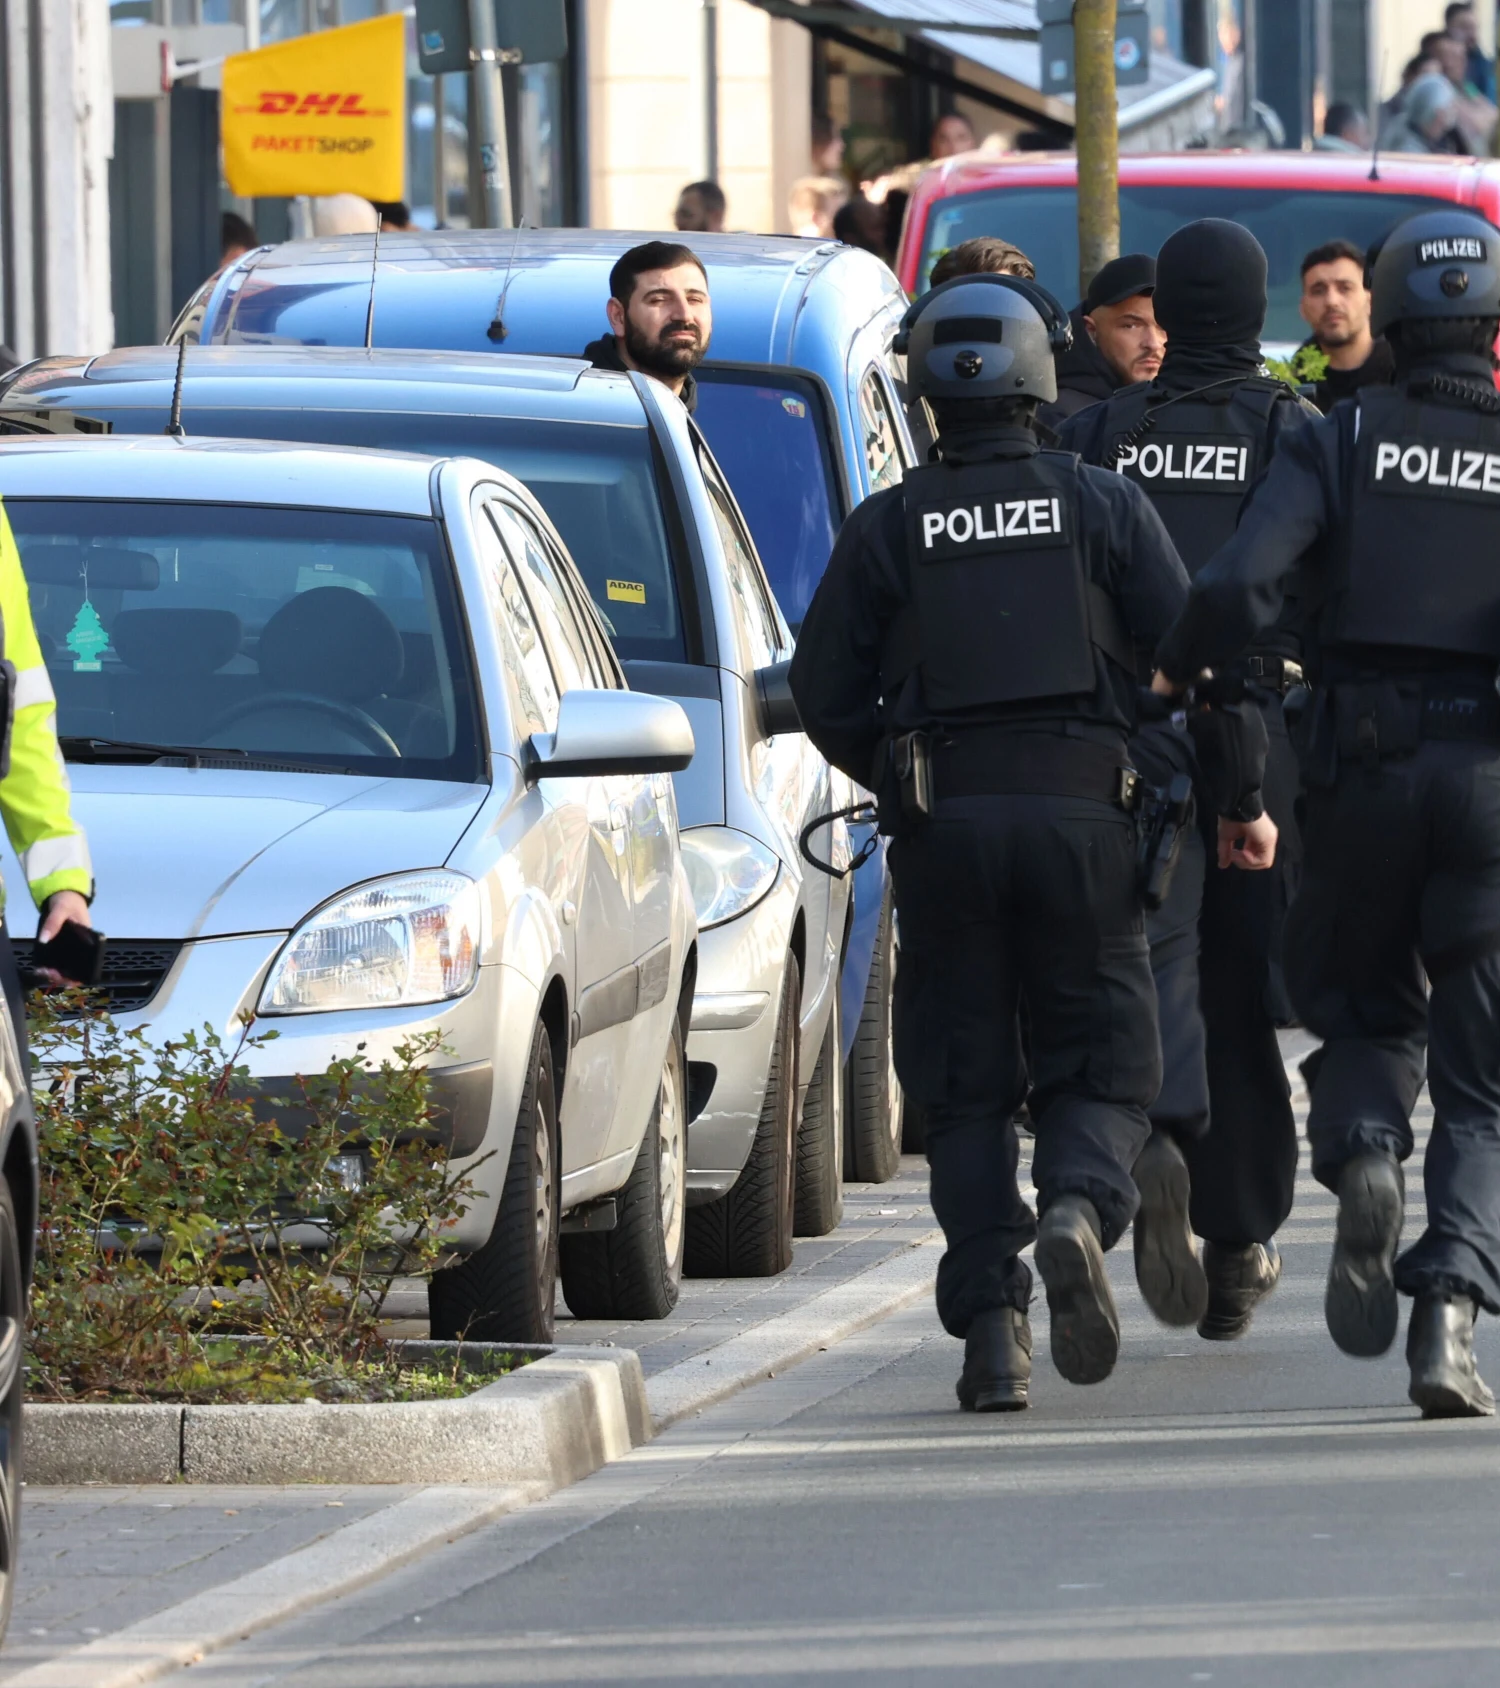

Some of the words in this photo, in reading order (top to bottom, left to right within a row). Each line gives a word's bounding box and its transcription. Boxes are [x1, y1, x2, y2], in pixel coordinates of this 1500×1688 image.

[258, 91, 367, 117] DHL
[252, 134, 375, 153] PAKETSHOP
[1421, 238, 1481, 261] POLIZEI
[1115, 443, 1248, 481] POLIZEI
[922, 497, 1062, 549] POLIZEI
[609, 581, 643, 592] ADAC
